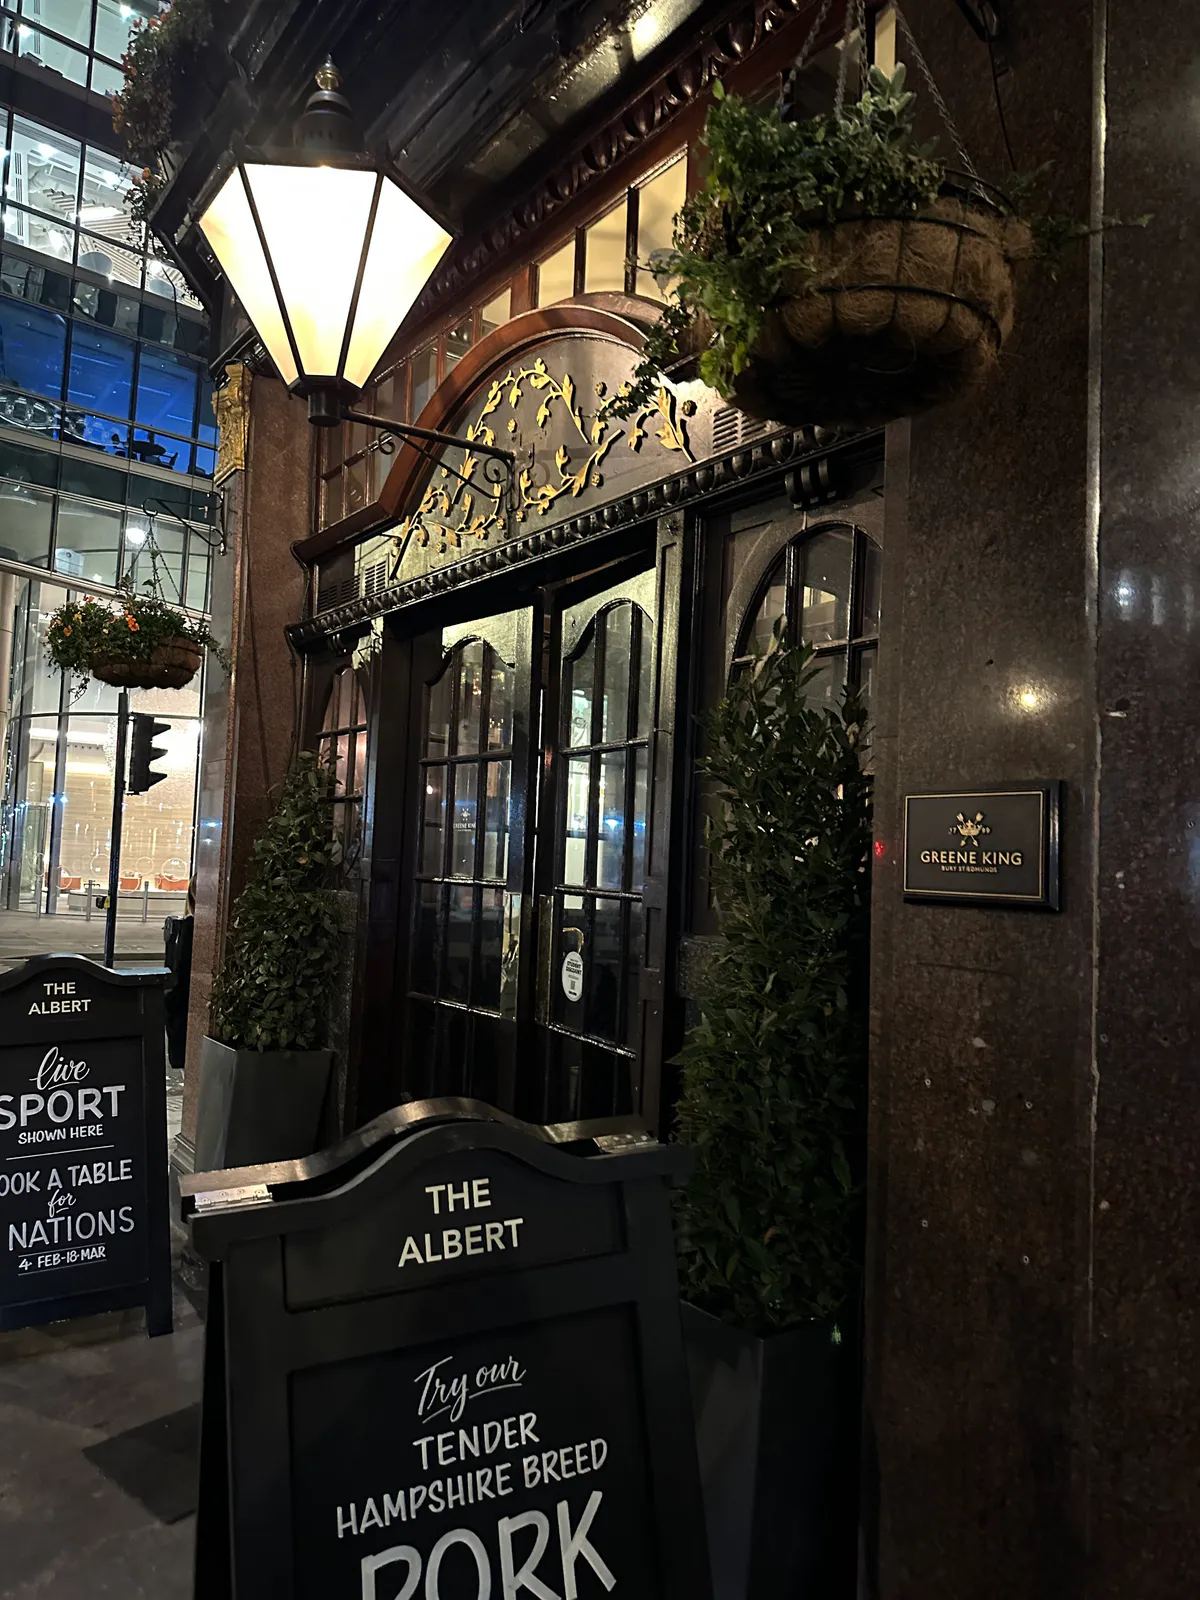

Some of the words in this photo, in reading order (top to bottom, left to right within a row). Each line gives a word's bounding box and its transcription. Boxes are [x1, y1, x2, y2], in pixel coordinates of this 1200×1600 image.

[920, 850, 977, 864] GREENE
[982, 851, 1022, 866] KING
[966, 865, 998, 873] EDMUNDS
[28, 999, 92, 1015] ALBERT
[43, 982, 76, 996] THE
[29, 1046, 90, 1091] live
[0, 1085, 125, 1130] SPORT
[18, 1128, 66, 1145] SHOWN
[70, 1124, 104, 1138] HERE
[47, 1168, 63, 1190] A
[68, 1159, 133, 1187] TABLE
[48, 1189, 77, 1218] for
[425, 1178, 491, 1214] THE
[9, 1206, 135, 1251] NATIONS
[398, 1218, 524, 1267] ALBERT
[18, 1258, 33, 1271] 4
[414, 1356, 469, 1423] Try
[476, 1355, 527, 1388] our
[412, 1412, 540, 1470] TENDER
[336, 1462, 514, 1538] HAMPSHIRE
[522, 1438, 608, 1488] BREED
[361, 1490, 617, 1600] PORK
